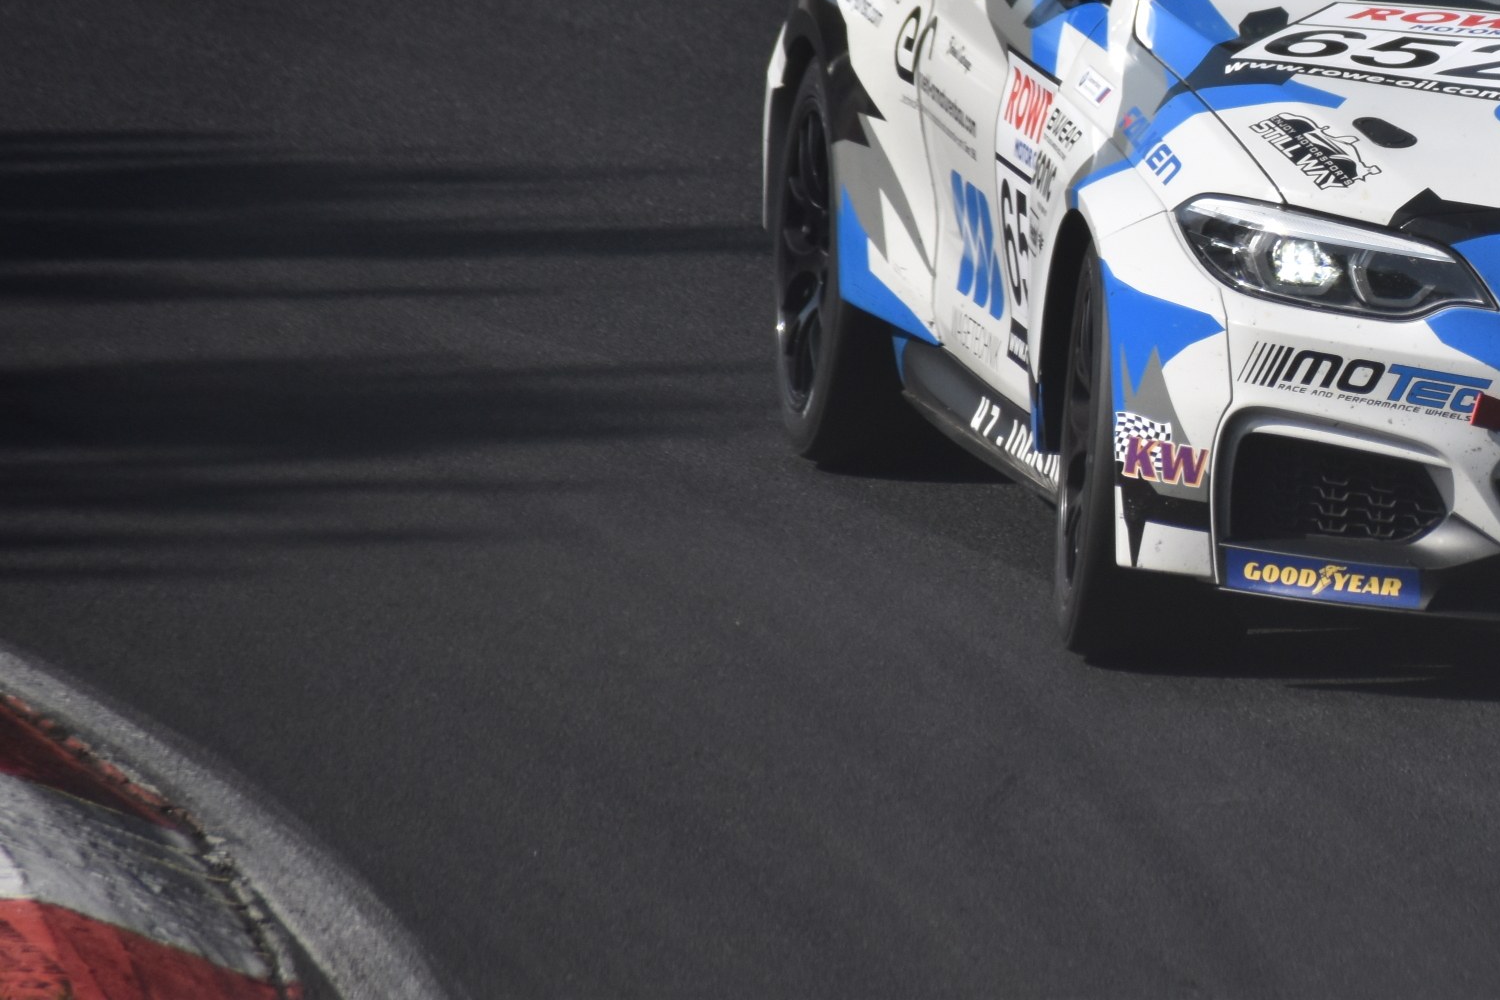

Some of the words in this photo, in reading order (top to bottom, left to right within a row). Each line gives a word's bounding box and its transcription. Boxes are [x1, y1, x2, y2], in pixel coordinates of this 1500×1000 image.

[1249, 119, 1302, 160] STILL
[1295, 153, 1345, 190] WAY
[1270, 115, 1296, 135] ENJOY
[1294, 134, 1354, 186] MOTORSPORTS
[1001, 178, 1029, 306] 65
[1277, 383, 1307, 394] RACE
[1310, 389, 1333, 399] AND
[1337, 394, 1420, 414] PERFORMANCE
[1424, 408, 1472, 422] WHEELS
[1282, 349, 1493, 414] MOTEC
[1123, 436, 1209, 488] KW
